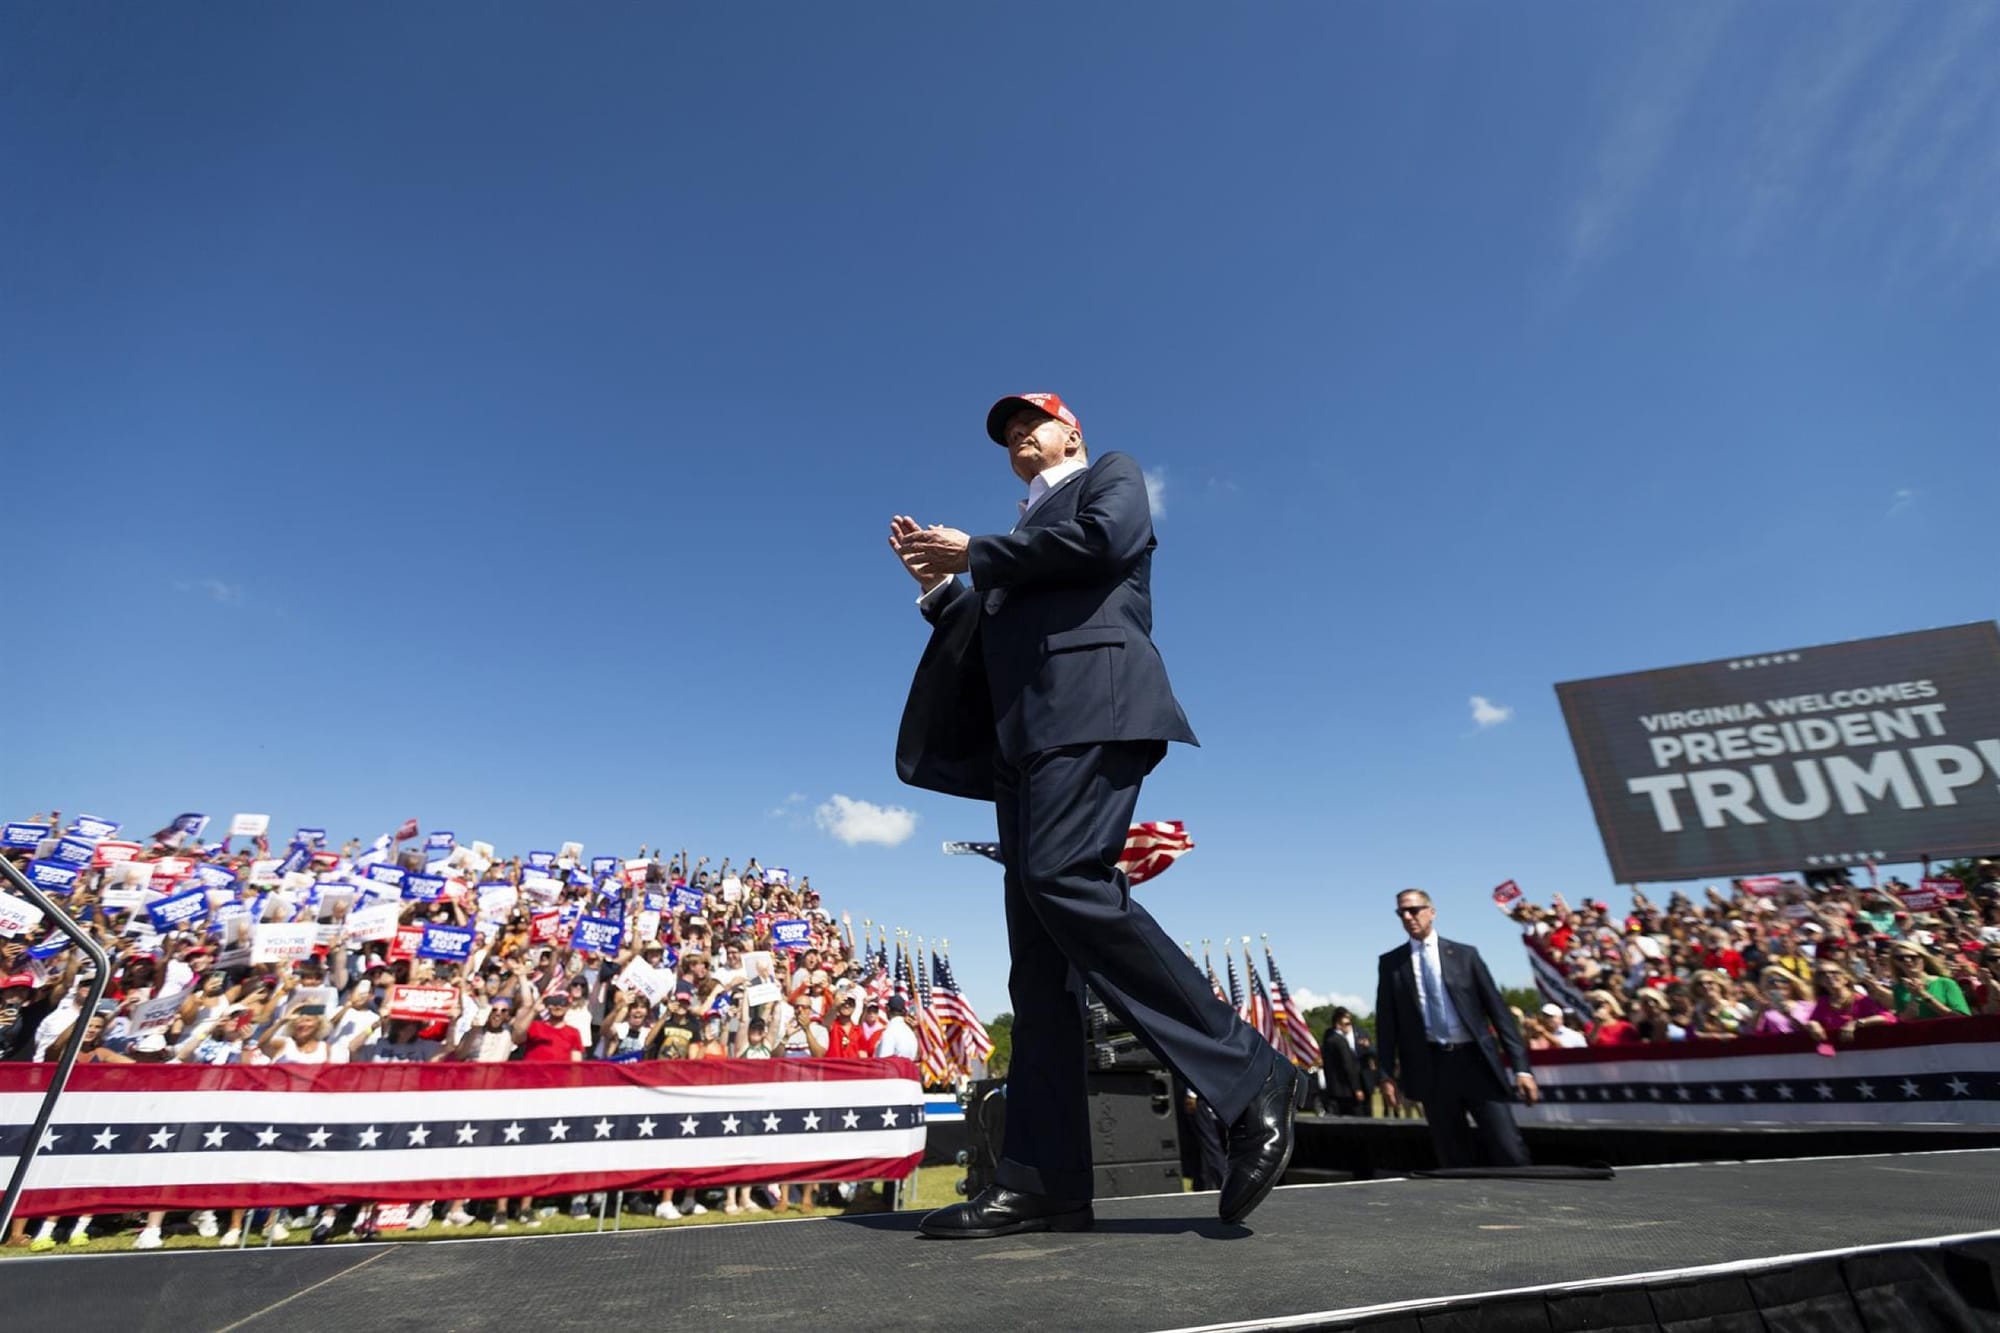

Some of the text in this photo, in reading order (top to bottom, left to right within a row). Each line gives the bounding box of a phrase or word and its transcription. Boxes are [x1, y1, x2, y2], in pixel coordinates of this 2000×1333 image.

[1640, 680, 1938, 733] VIRGINIA WELCOMES
[1649, 703, 1947, 768] PRESIDENT
